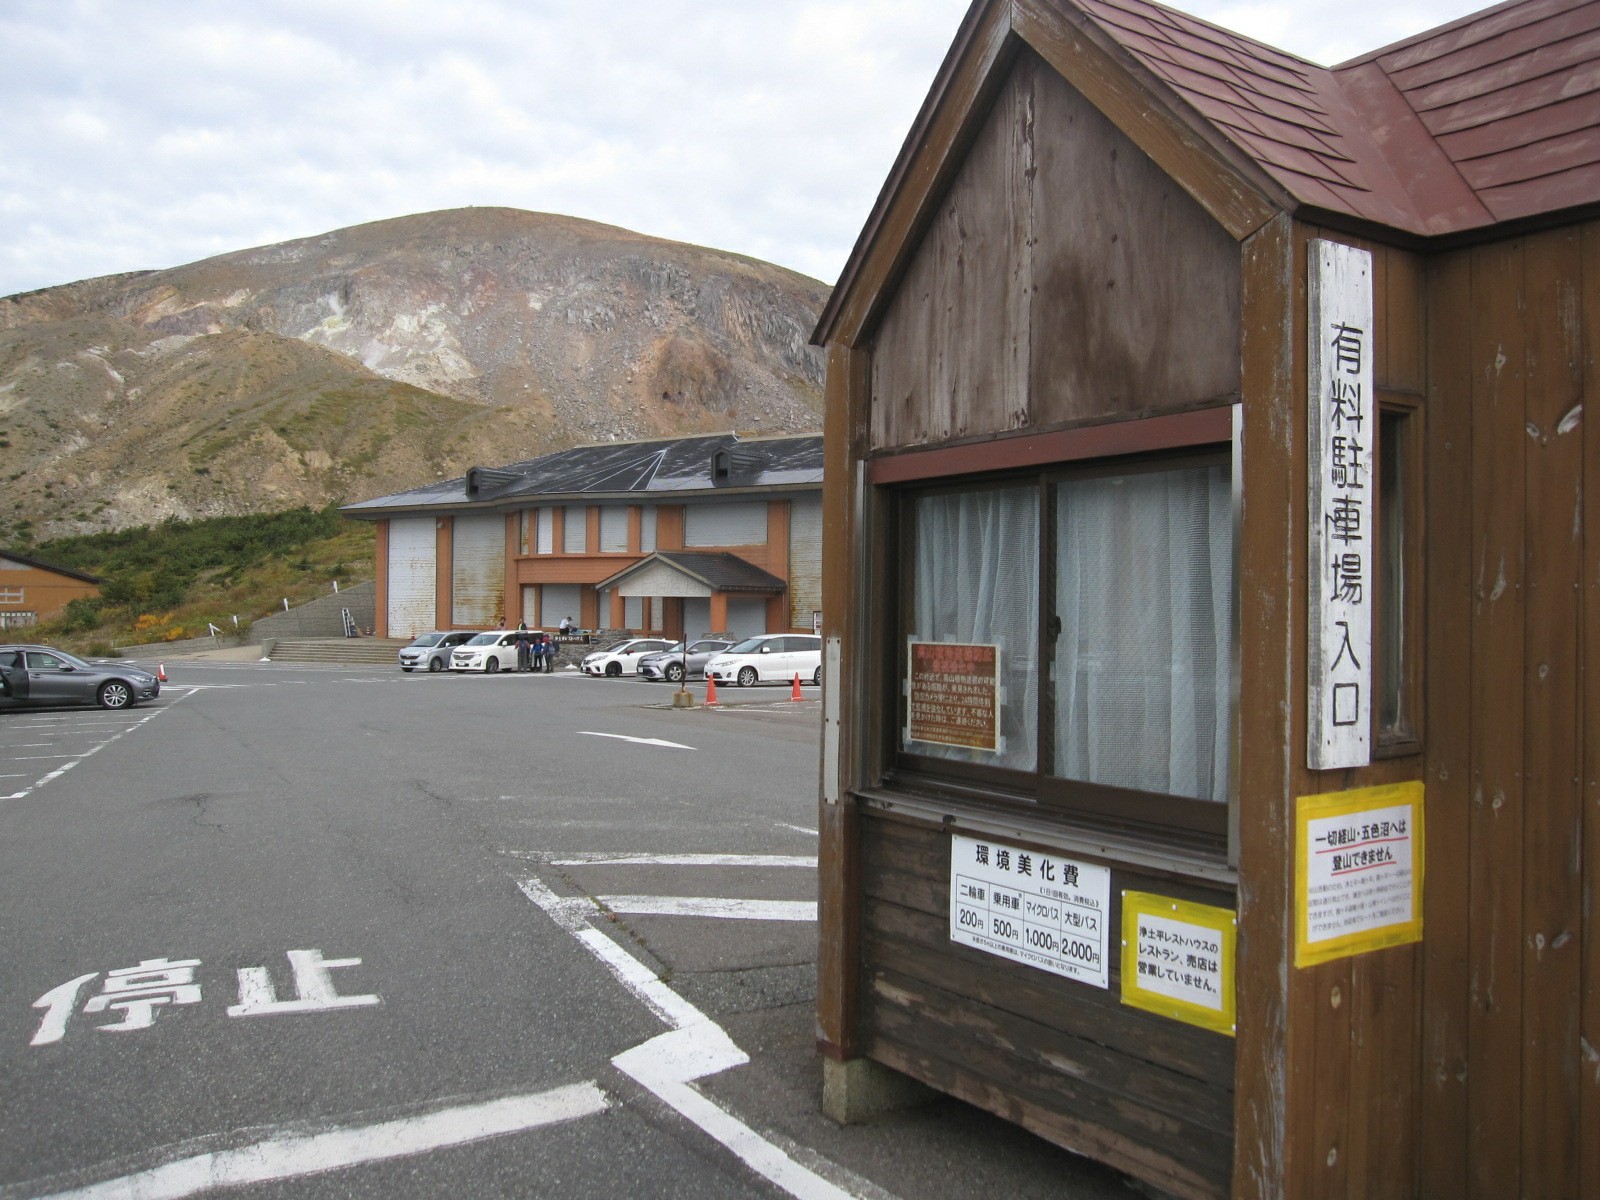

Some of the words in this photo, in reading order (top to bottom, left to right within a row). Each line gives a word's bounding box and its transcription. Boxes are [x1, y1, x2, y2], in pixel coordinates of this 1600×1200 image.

[1329, 321, 1364, 728] 有料駐車場入口
[1315, 819, 1407, 847] 一切経山・五色沼へは
[975, 843, 1079, 888] 環境美化費
[1332, 846, 1393, 872] 登山できません
[960, 883, 986, 902] 二輪車
[960, 908, 984, 930] 200円
[1025, 901, 1059, 921] マイクロバス
[1064, 910, 1098, 932] 大型バス
[993, 918, 1019, 941] 500円
[1025, 927, 1060, 953] 1,000円
[1139, 925, 1219, 954] 浄土平レストハウスの
[1061, 938, 1100, 965] 2,000円
[1138, 943, 1218, 974] レストラン、売店は
[1138, 961, 1217, 994] 営業していません。
[29, 948, 381, 1047] 停止
